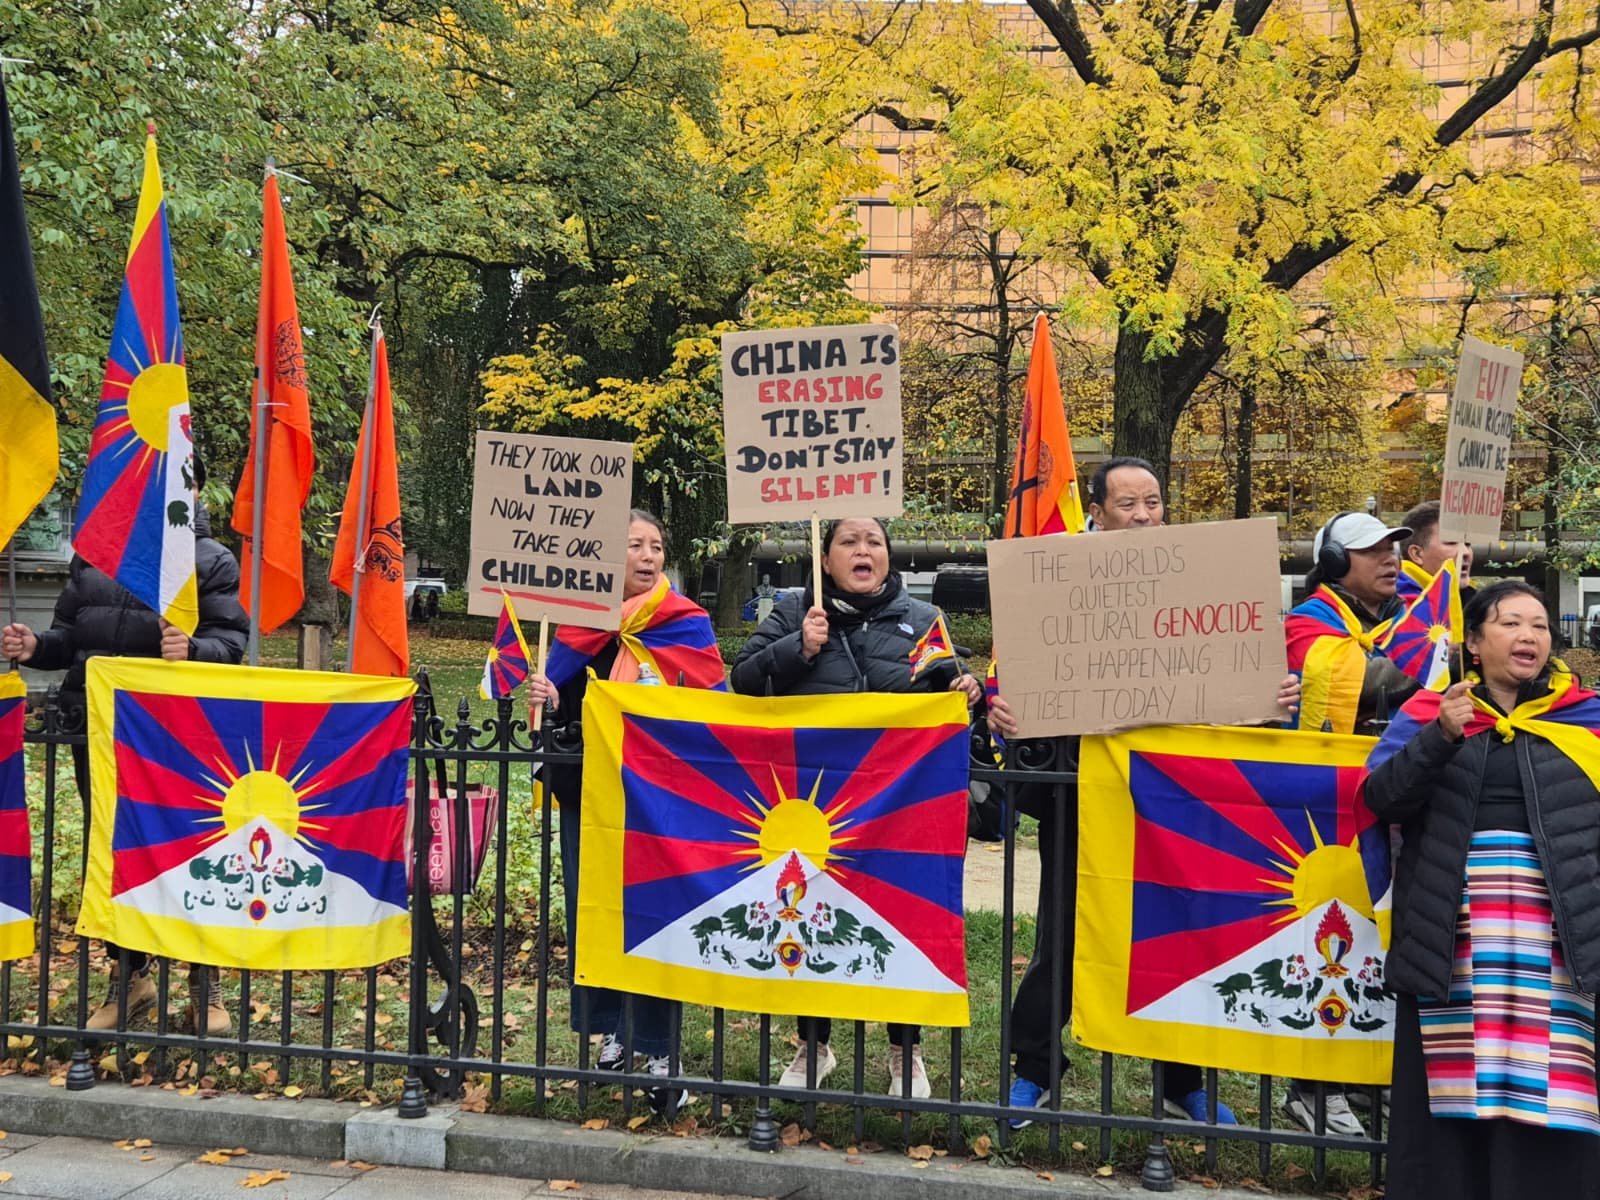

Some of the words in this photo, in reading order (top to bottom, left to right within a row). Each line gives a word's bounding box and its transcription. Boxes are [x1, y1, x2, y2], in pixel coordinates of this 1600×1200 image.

[731, 339, 847, 376] CHINA
[860, 335, 897, 365] IS
[758, 373, 883, 403] ERASING
[1475, 358, 1511, 408] EU!
[761, 407, 871, 437] TIBET.
[1453, 400, 1484, 430] HUMAN
[488, 441, 536, 469] THEY
[542, 448, 582, 473] TOOK
[590, 455, 626, 478] OUR
[833, 437, 895, 464] STAY
[1458, 437, 1494, 470] CANNOT
[1495, 446, 1506, 471] BE
[524, 474, 603, 498] LAND
[761, 470, 891, 503] SILENT!
[1444, 480, 1504, 517] NEGOTIATED
[490, 497, 535, 522] NOW
[548, 505, 595, 529] THEY
[512, 530, 560, 554] TAKE
[566, 538, 603, 560] OUR
[482, 558, 613, 593] CHILDREN
[1024, 550, 1070, 584] THE
[1069, 579, 1161, 612] QUIETEST
[1041, 611, 1146, 647] CULTURAL
[1153, 601, 1265, 639] GENOCIDE
[1054, 653, 1074, 682] IS
[1087, 643, 1211, 681] HAPPENING
[1233, 640, 1261, 673] IN
[1015, 689, 1080, 721] TIBET
[1093, 685, 1177, 721] TODAY
